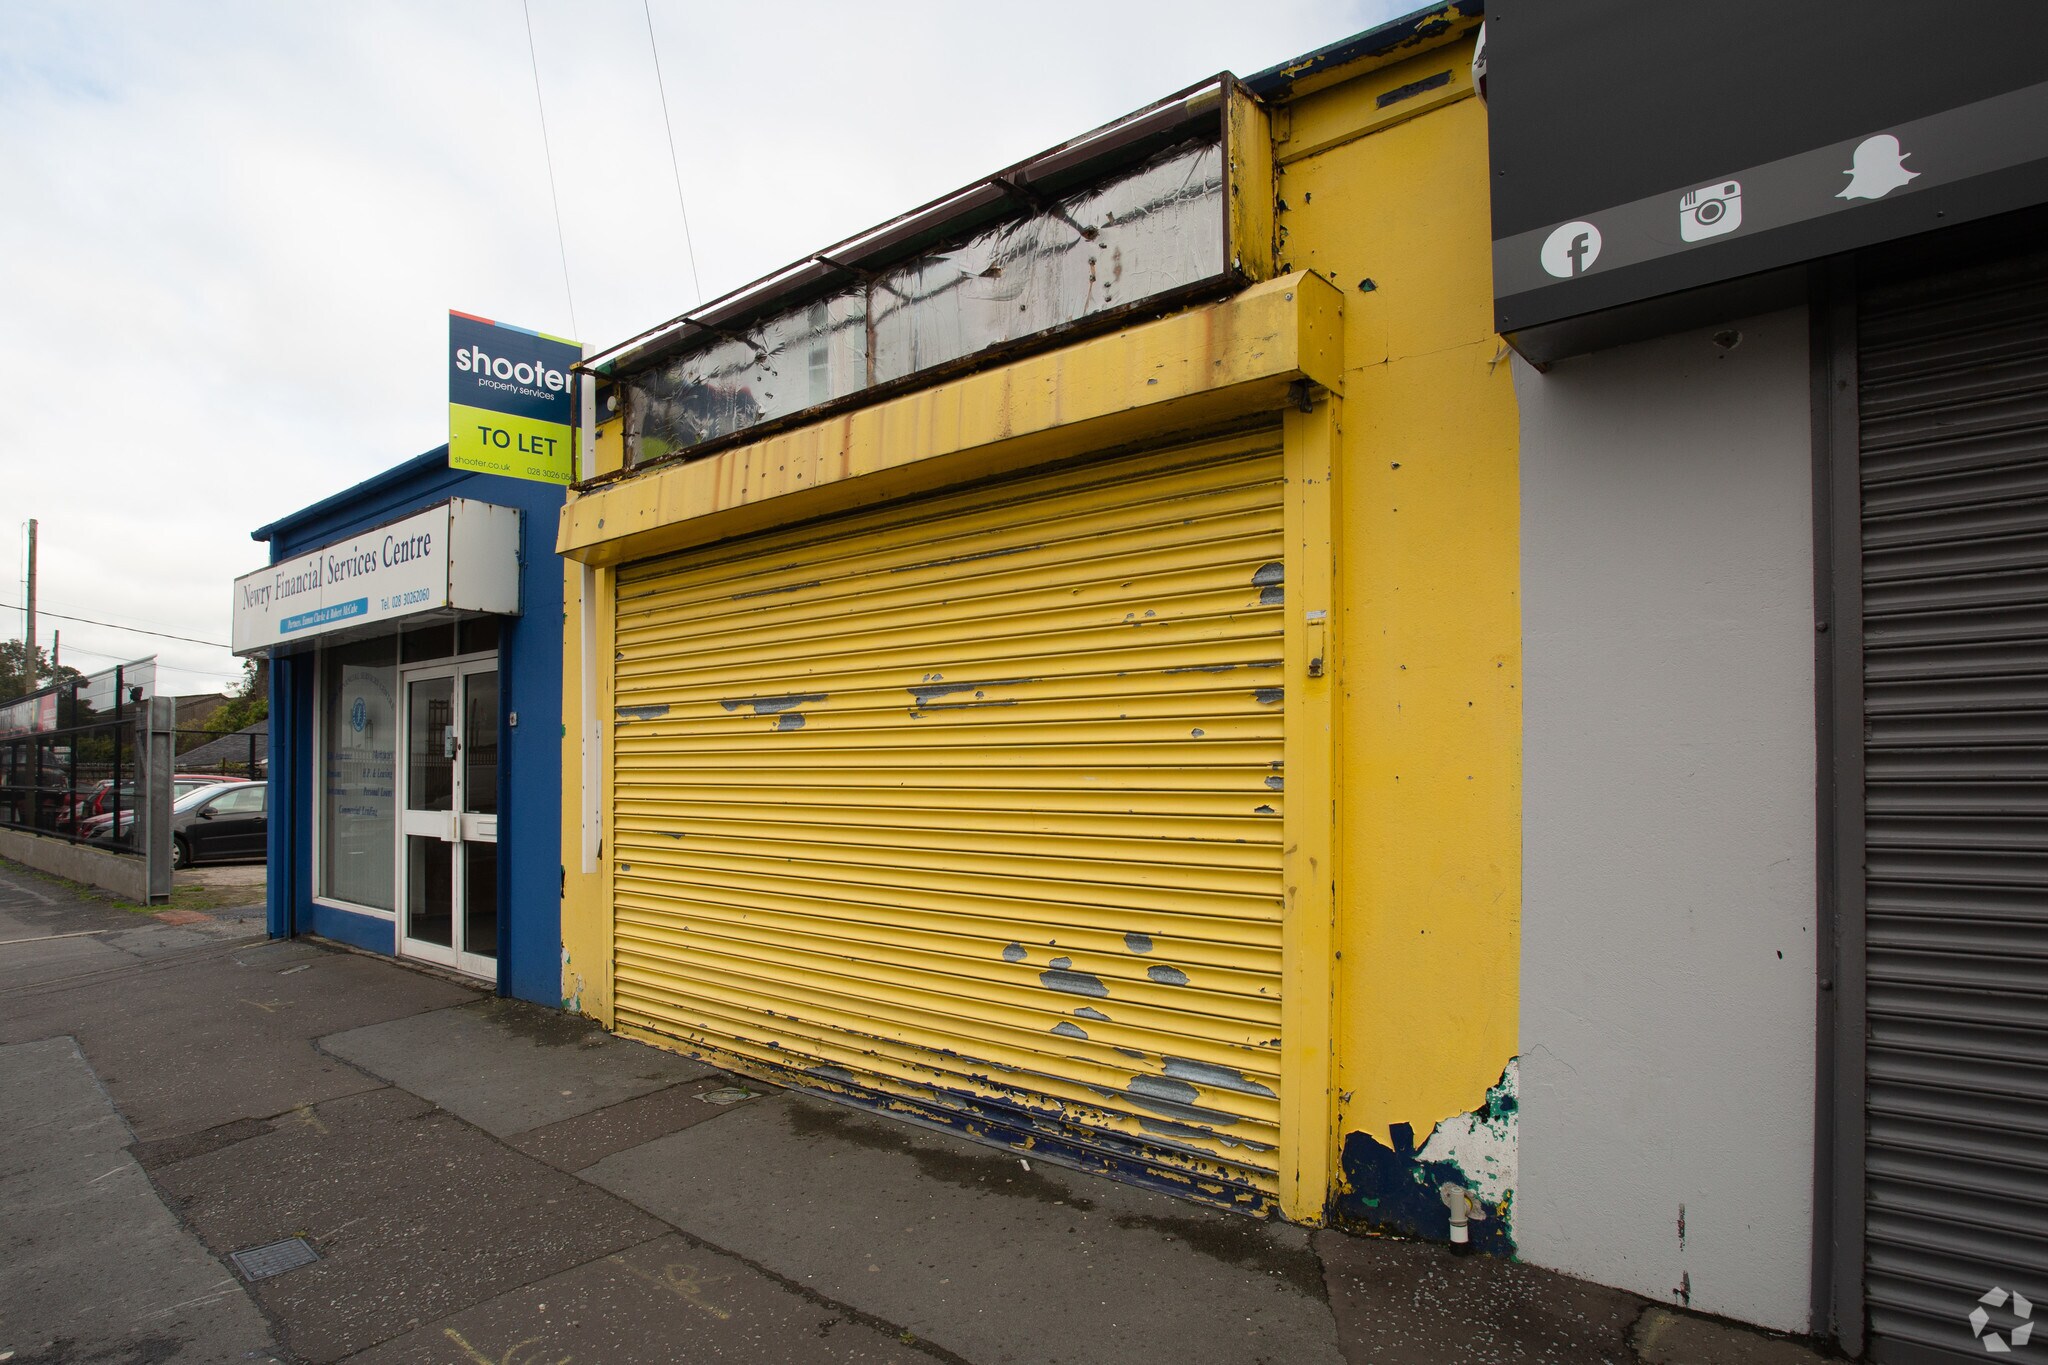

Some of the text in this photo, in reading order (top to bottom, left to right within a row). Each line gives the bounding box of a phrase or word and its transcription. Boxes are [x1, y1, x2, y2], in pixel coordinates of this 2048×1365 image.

[456, 345, 571, 394] shooter
[478, 377, 555, 401] property services
[477, 425, 558, 457] TO LET
[454, 455, 511, 472] shooter.co.uk
[527, 467, 541, 476] 028
[542, 469, 560, 479] 3026
[242, 532, 432, 613] Newry Financial Services Centre
[391, 594, 402, 609] 028
[403, 587, 430, 606] 30262060
